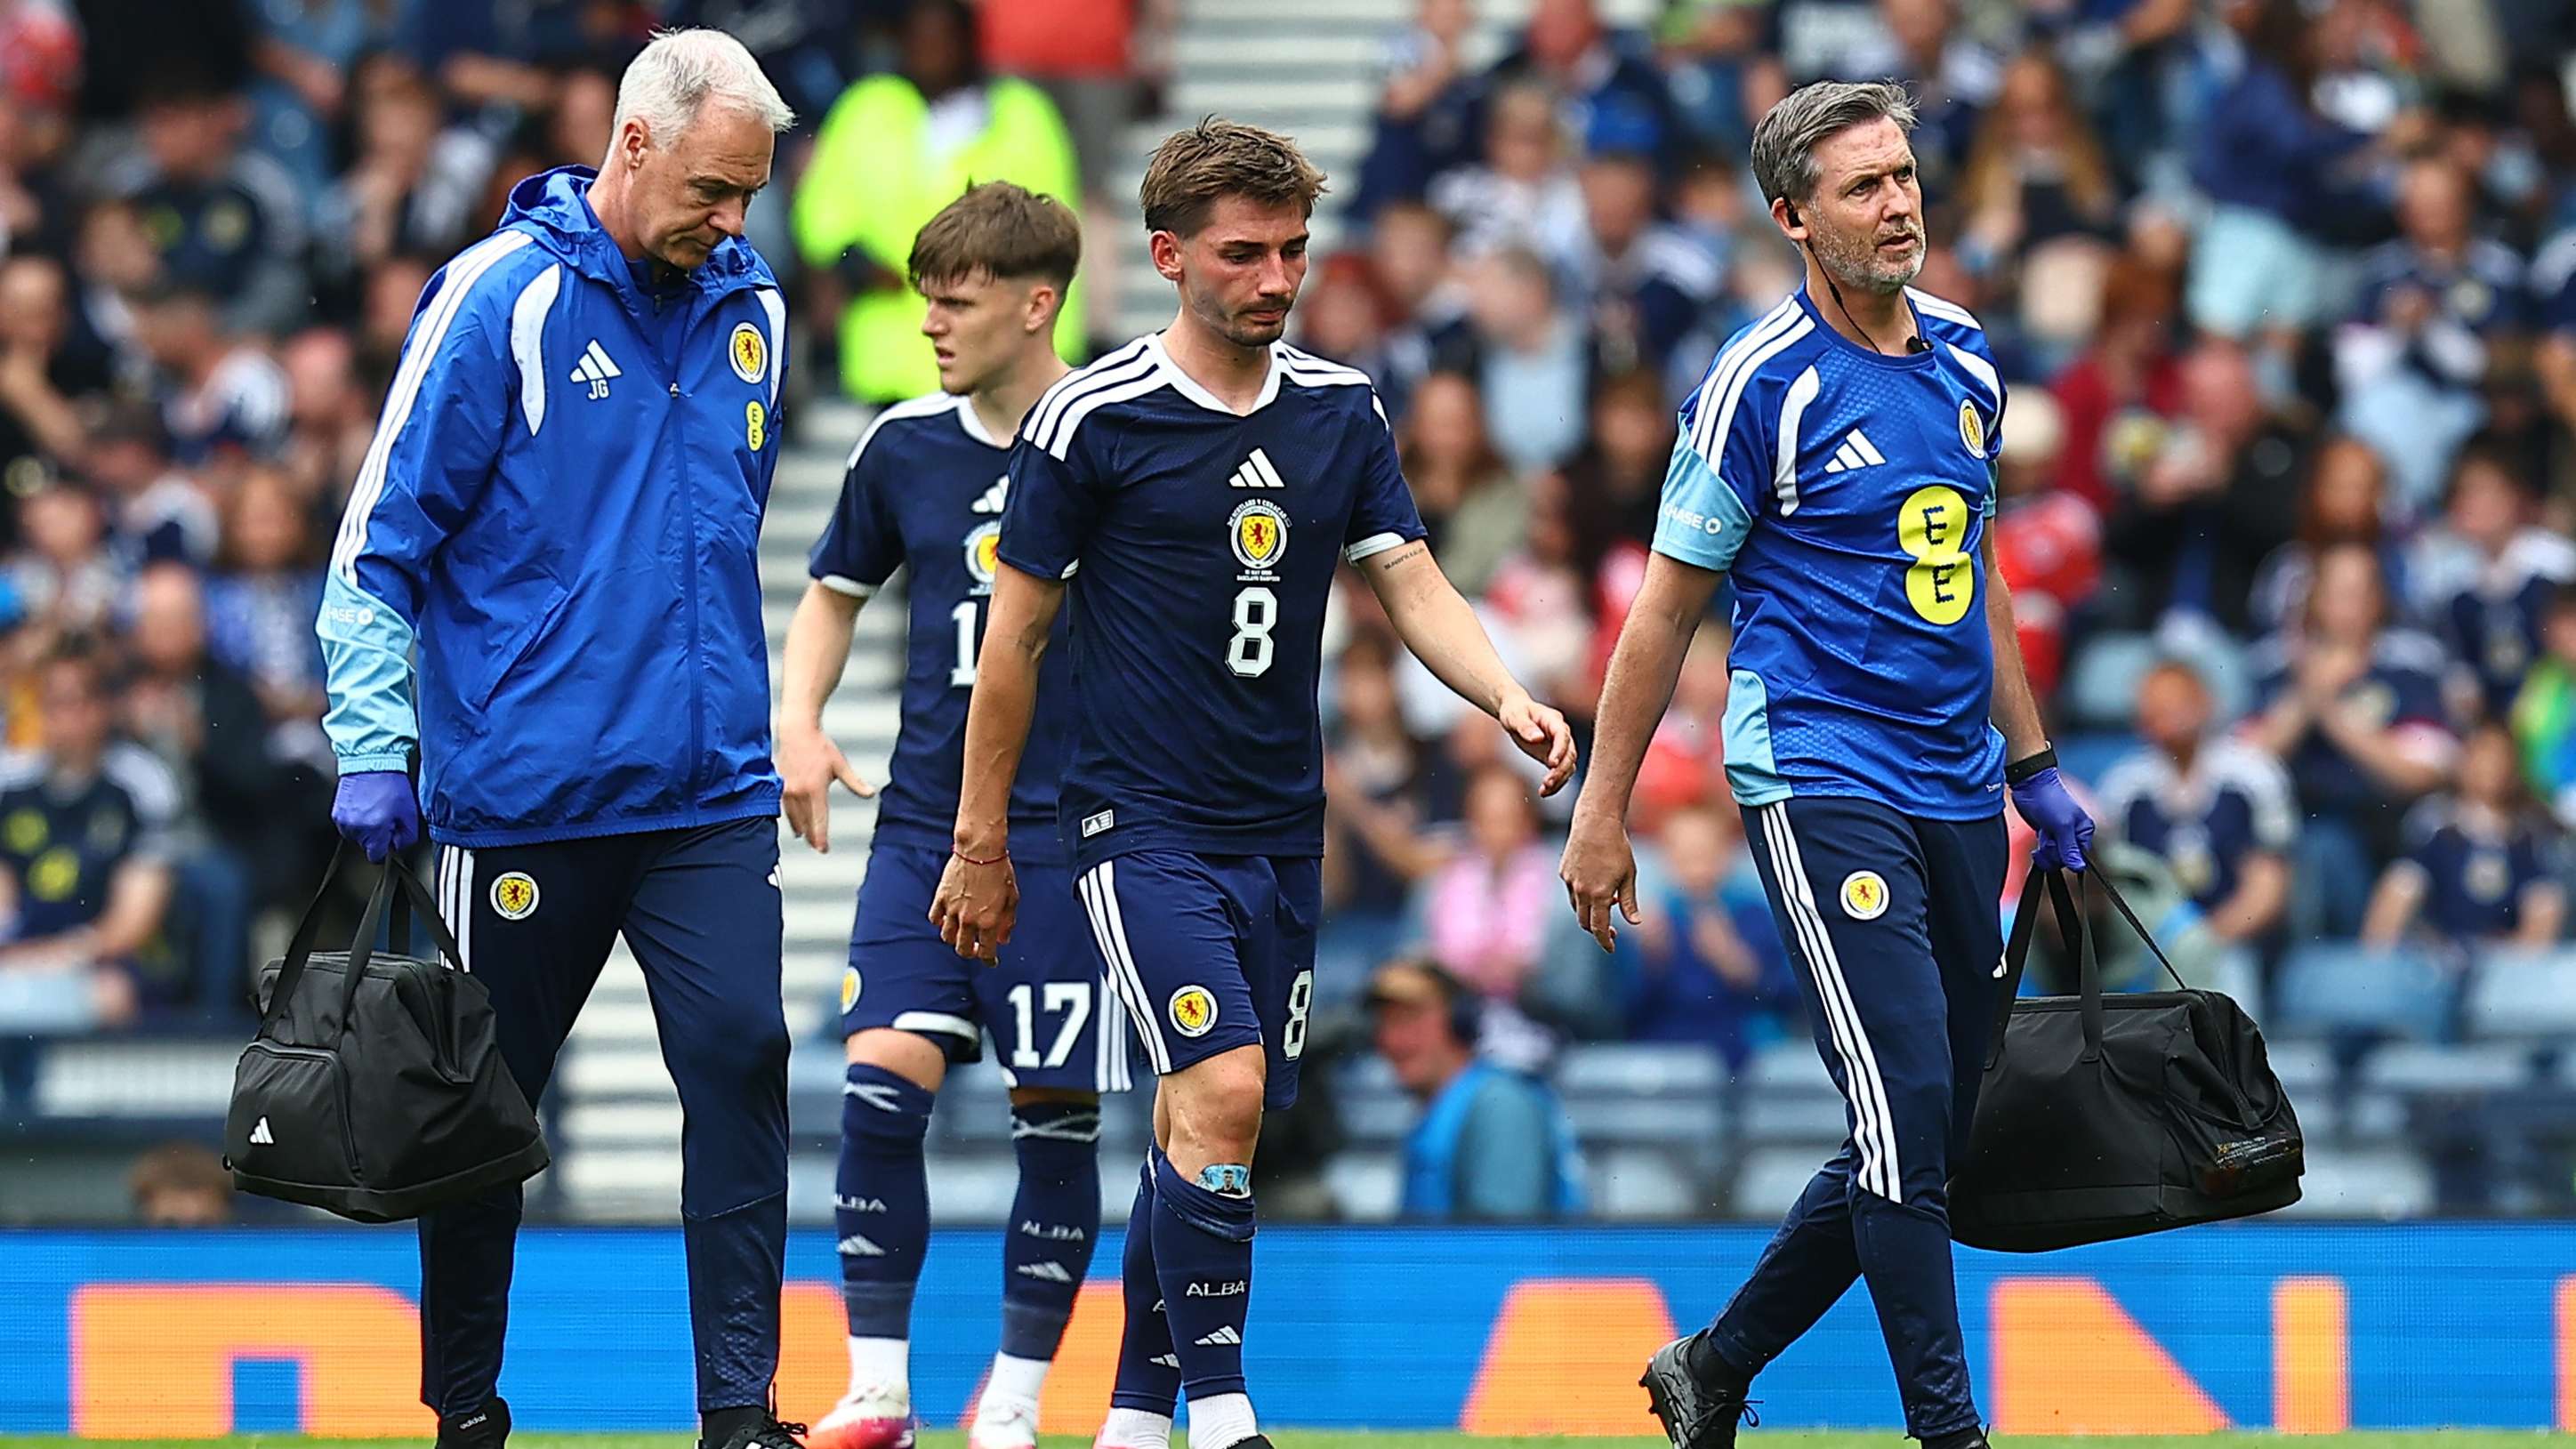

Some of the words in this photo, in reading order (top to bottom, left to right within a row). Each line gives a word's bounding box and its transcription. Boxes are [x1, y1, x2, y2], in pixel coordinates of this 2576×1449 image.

[587, 379, 610, 400] JG
[325, 605, 356, 624] HASE
[1225, 586, 1277, 678] 8
[950, 600, 978, 687] 1
[1007, 981, 1091, 1068] 17
[1282, 970, 1313, 1061] 8
[1021, 1220, 1084, 1241] ALBA
[1186, 1280, 1246, 1297] ALBA
